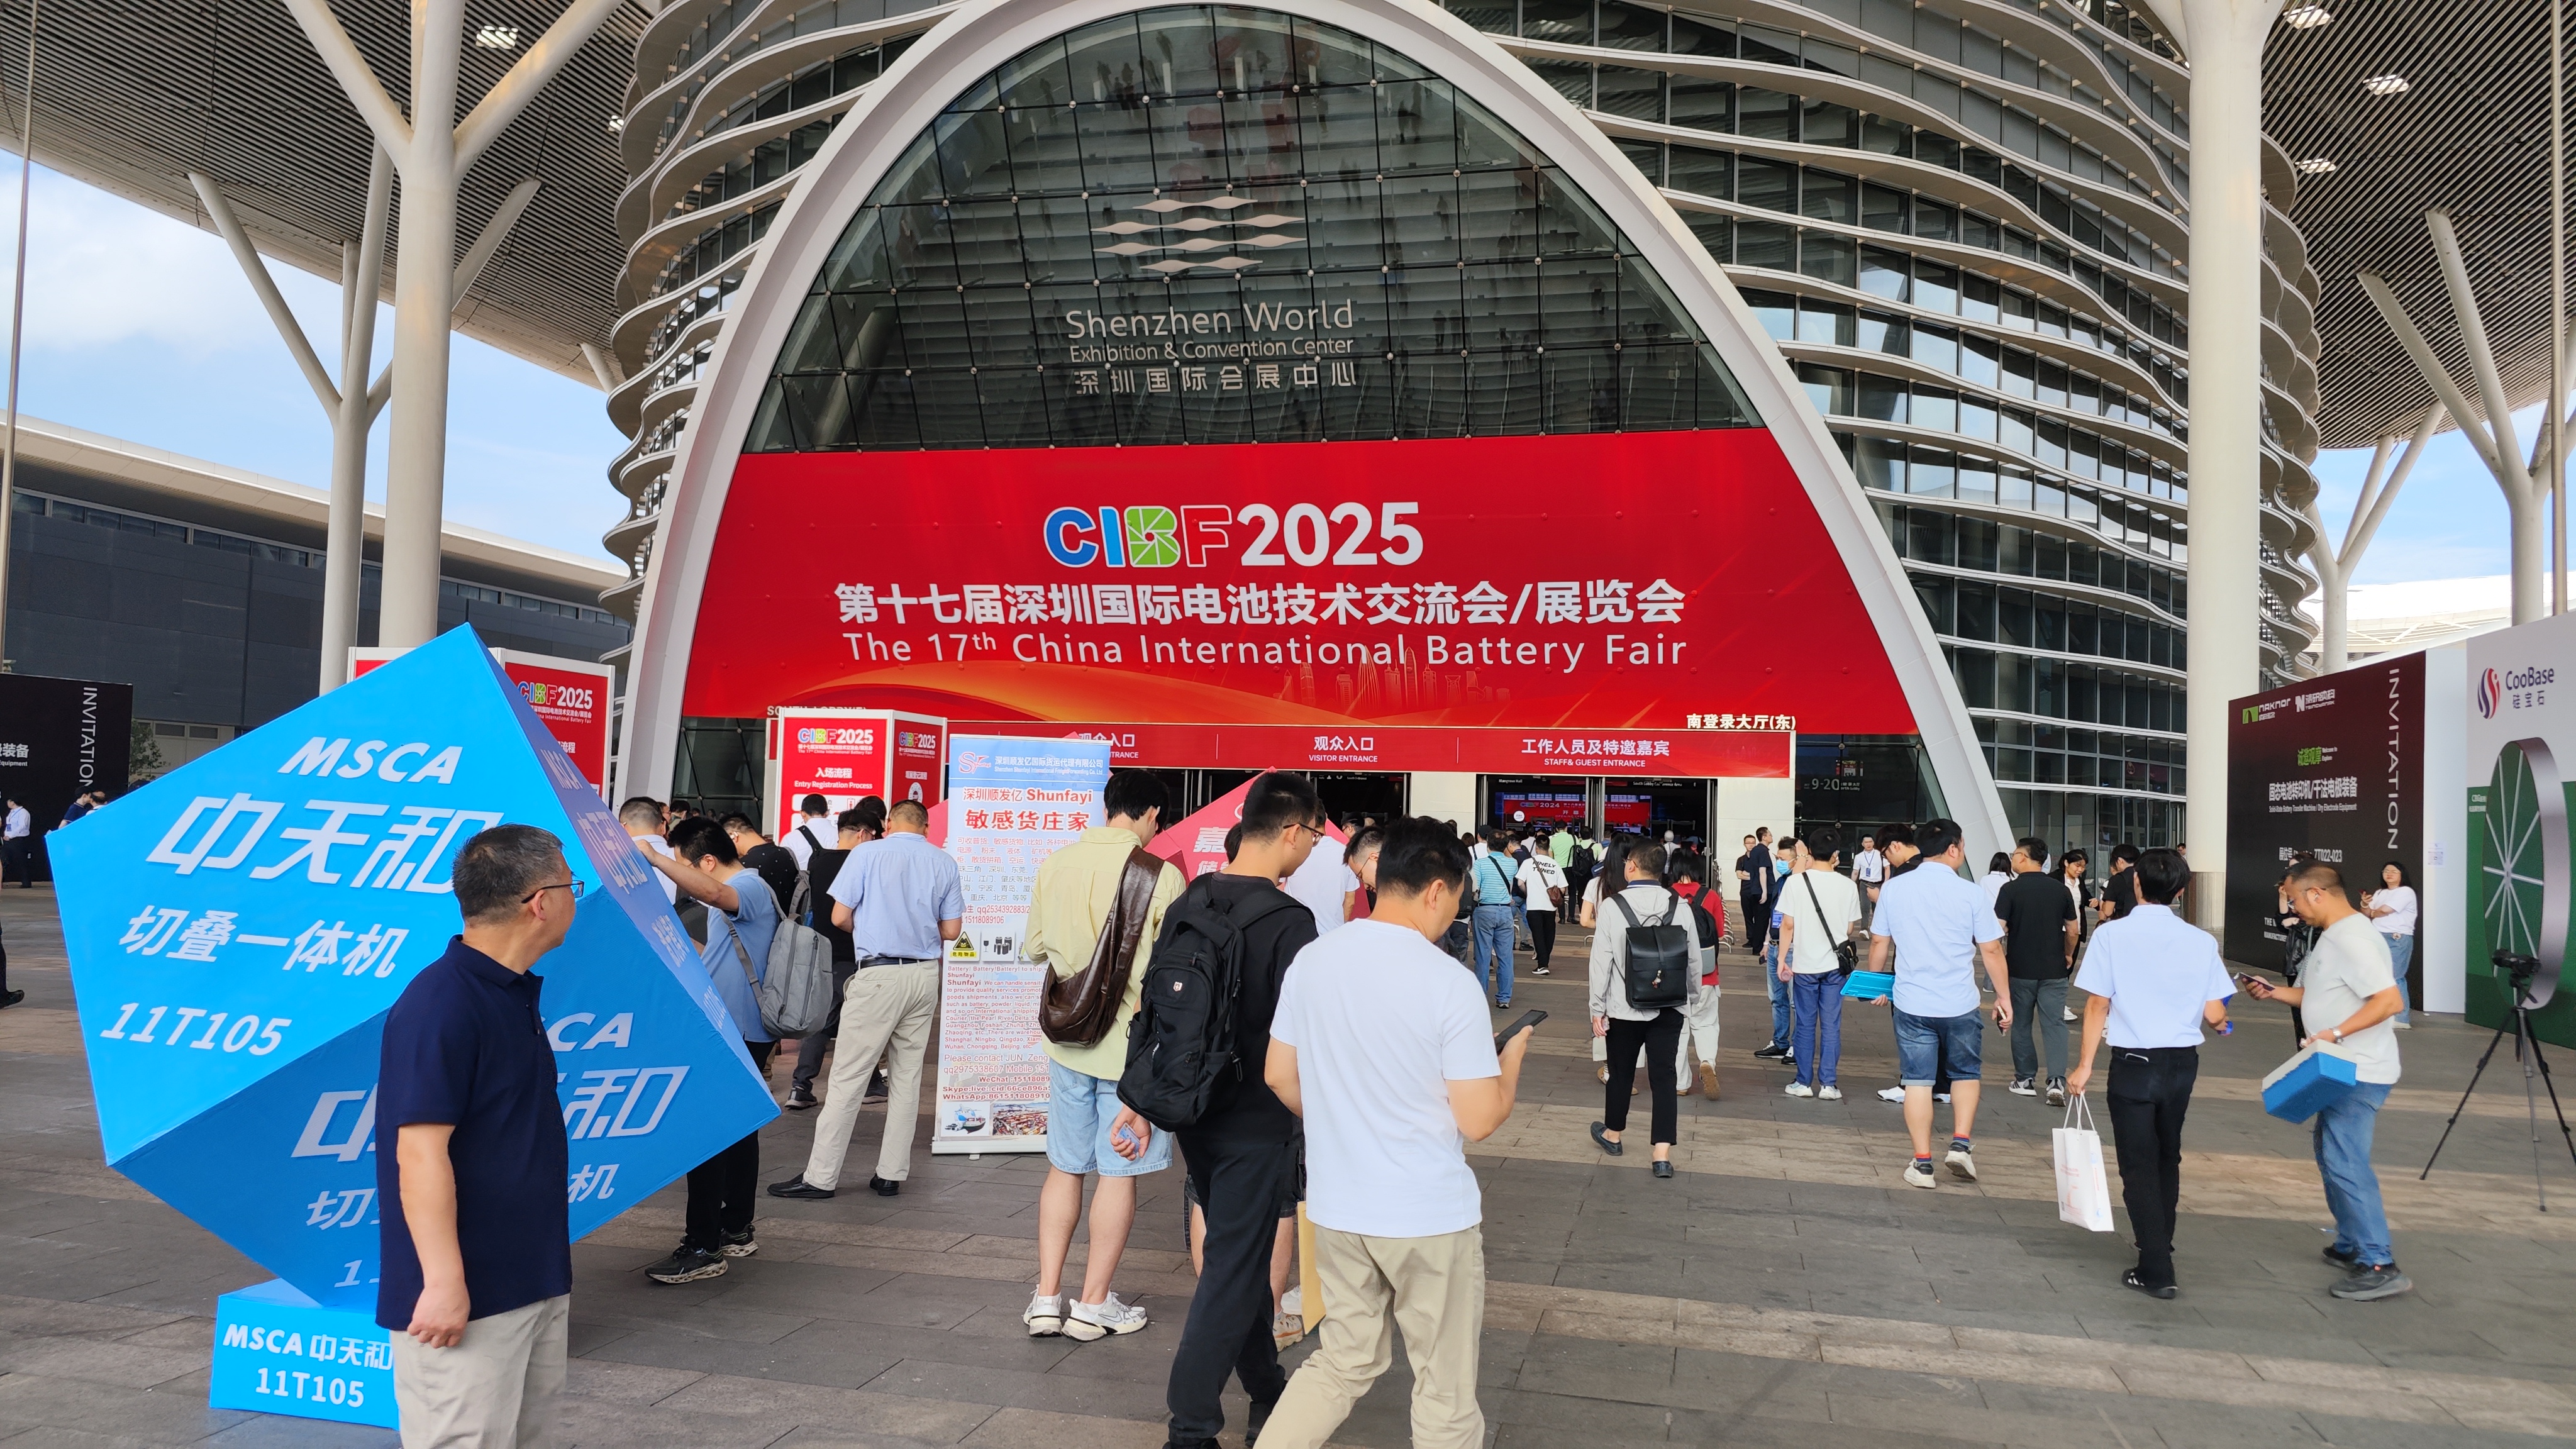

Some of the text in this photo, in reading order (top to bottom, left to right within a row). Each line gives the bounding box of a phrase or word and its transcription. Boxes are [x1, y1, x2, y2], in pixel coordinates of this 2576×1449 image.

[1065, 299, 1353, 339] Shenzhen World
[1070, 336, 1354, 363] Exhibition & Convention Center
[1075, 362, 1357, 395] 深圳国际会展中心
[834, 579, 1686, 626] 第十七届深圳国际电池技术交流会/展览会
[843, 631, 1687, 673] The 17th China International Battery Fair
[2506, 667, 2555, 691] CooBase
[1686, 713, 1796, 730] 南登录大厅(东)
[1314, 736, 1374, 752] 观众入口
[1521, 739, 1670, 757] 工作人员及特邀嘉宾
[278, 736, 463, 785] MSCA
[1544, 758, 1574, 767] STAFF&
[1603, 759, 1646, 768] ENTRANCE
[2387, 668, 2400, 849] INVITATION
[794, 780, 811, 789] Entry
[812, 781, 848, 789] Registration
[815, 767, 852, 779] 入场流程
[1812, 779, 1840, 791] 9-20
[963, 788, 1092, 805] 深圳顺发亿 Shunfayi
[965, 809, 1089, 831] 敏感货庄家
[146, 792, 504, 894] 中天和
[119, 905, 409, 977] 切叠一体机
[101, 1002, 292, 1056] 11T105
[542, 1012, 634, 1052] CA
[944, 1065, 1004, 1074] qq2975338607
[1028, 1054, 1048, 1063] Zeng
[223, 1324, 394, 1371] MSCA 中天和
[255, 1367, 365, 1409] 11T105
